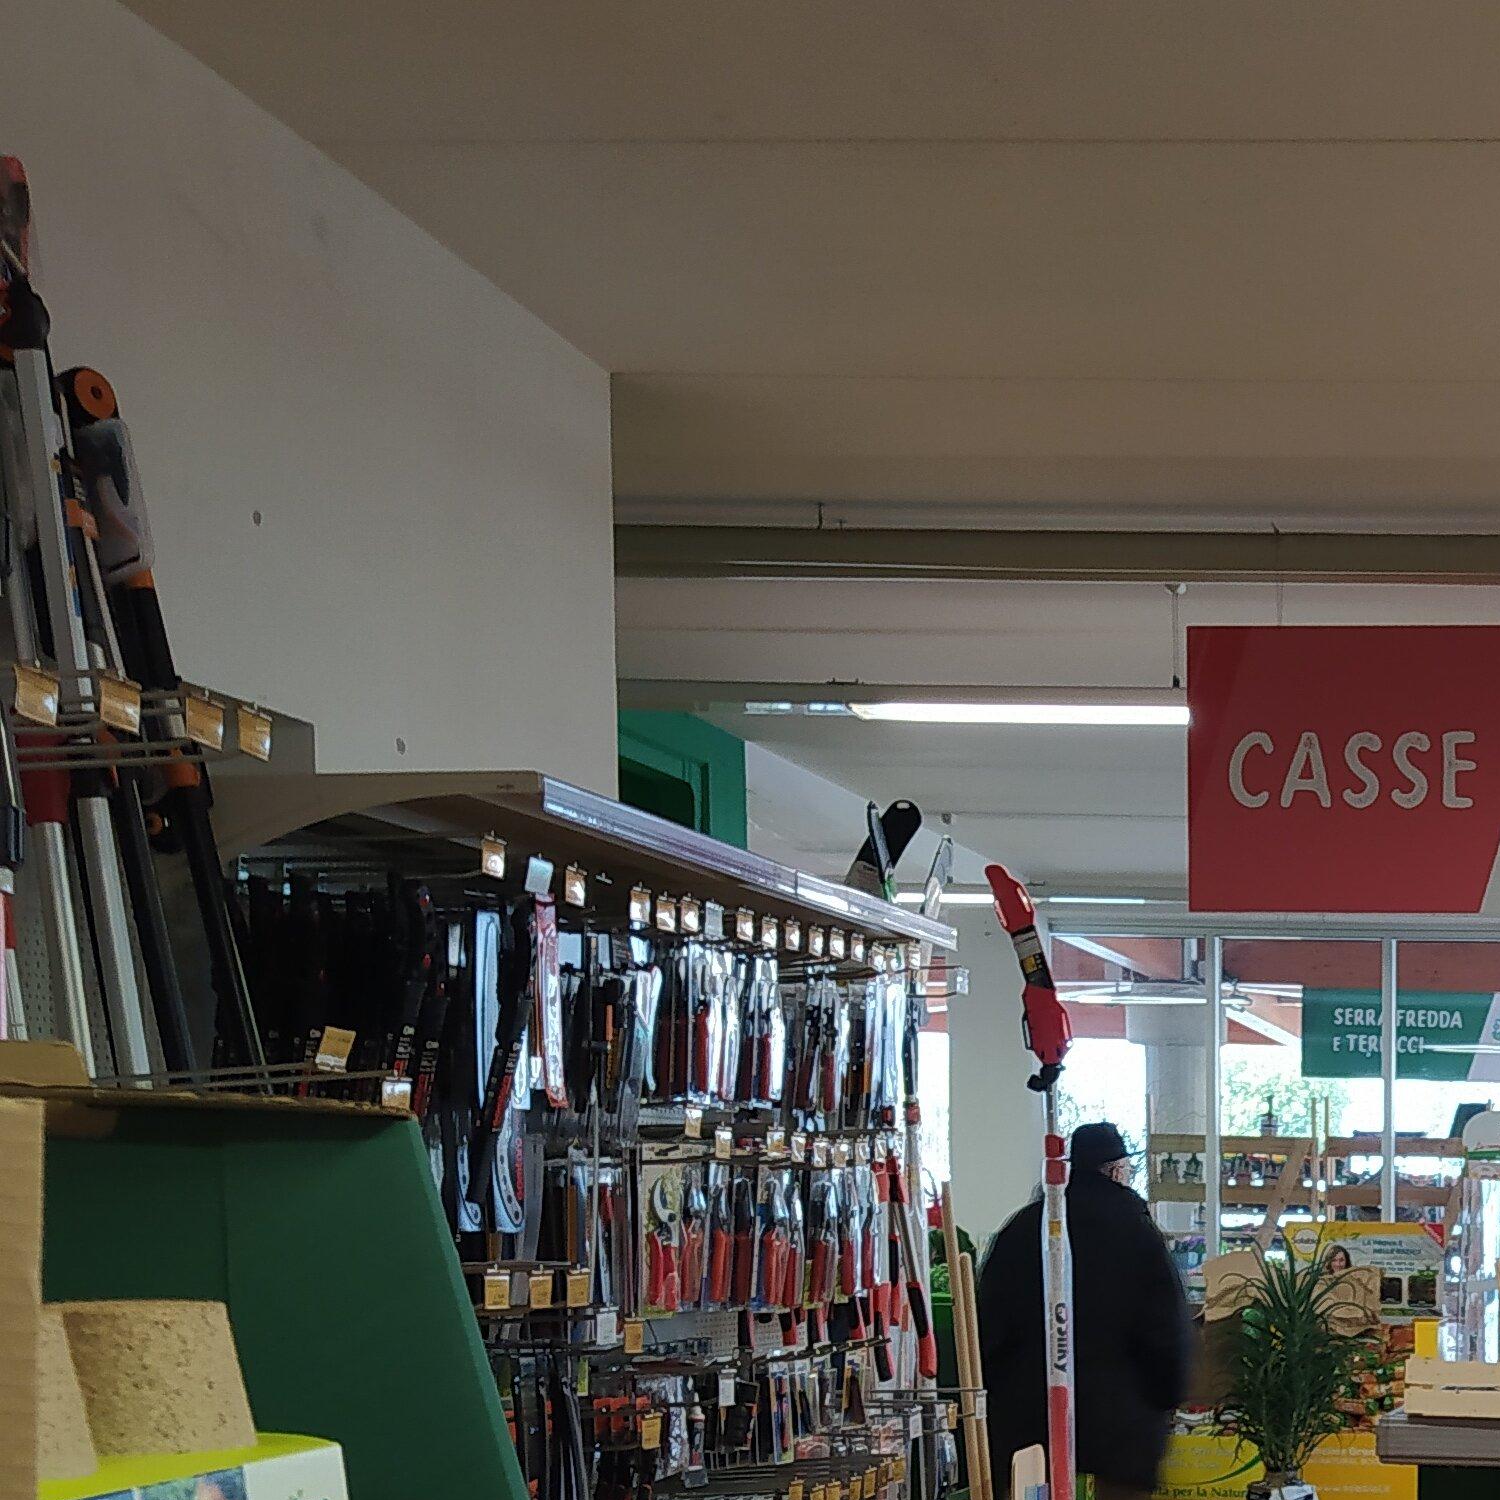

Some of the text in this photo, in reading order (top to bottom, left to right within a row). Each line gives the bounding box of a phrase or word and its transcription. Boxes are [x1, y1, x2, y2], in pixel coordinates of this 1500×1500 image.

[1228, 731, 1477, 809] CASSE
[1396, 1009, 1463, 1029] FREDDA
[1333, 1034, 1424, 1054] E TERCCI
[1211, 1487, 1247, 1498] Natur
